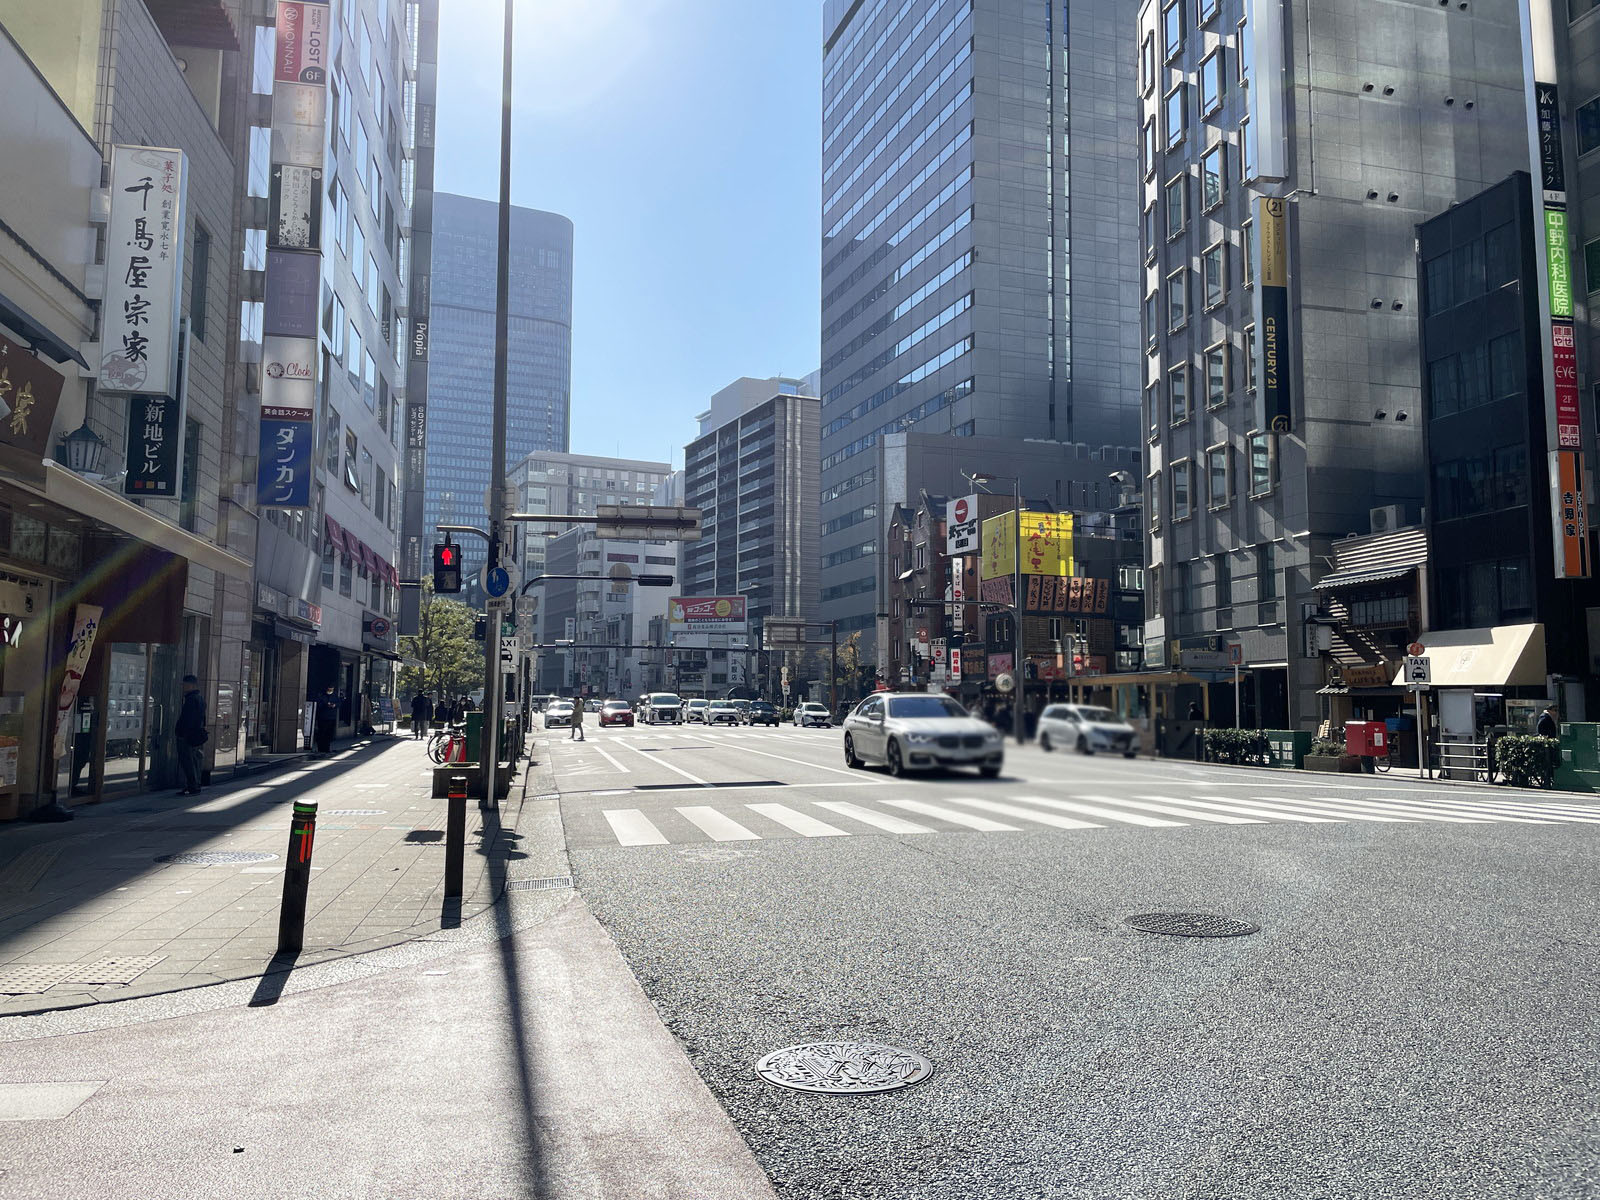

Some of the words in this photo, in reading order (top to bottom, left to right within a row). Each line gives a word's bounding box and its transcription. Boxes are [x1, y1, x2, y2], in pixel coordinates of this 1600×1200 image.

[309, 31, 321, 64] LOST
[306, 71, 320, 81] 6F
[1541, 108, 1554, 186] 加藤クリニック
[162, 160, 176, 194] 菓子処
[1271, 201, 1282, 212] 21
[123, 176, 154, 363] 千鳥屋宗家
[1548, 212, 1569, 315] 中野内科医院
[413, 322, 427, 356] Propia
[1266, 317, 1277, 376] CENTURY
[286, 362, 312, 376] Clock
[1268, 378, 1277, 389] 21
[264, 408, 310, 417] 英会話スクール
[1563, 395, 1572, 404] 2F
[141, 399, 165, 475] 新地ビル
[275, 426, 298, 502] ダンカン
[1563, 492, 1576, 537] 吉野家
[501, 639, 516, 647] AXI
